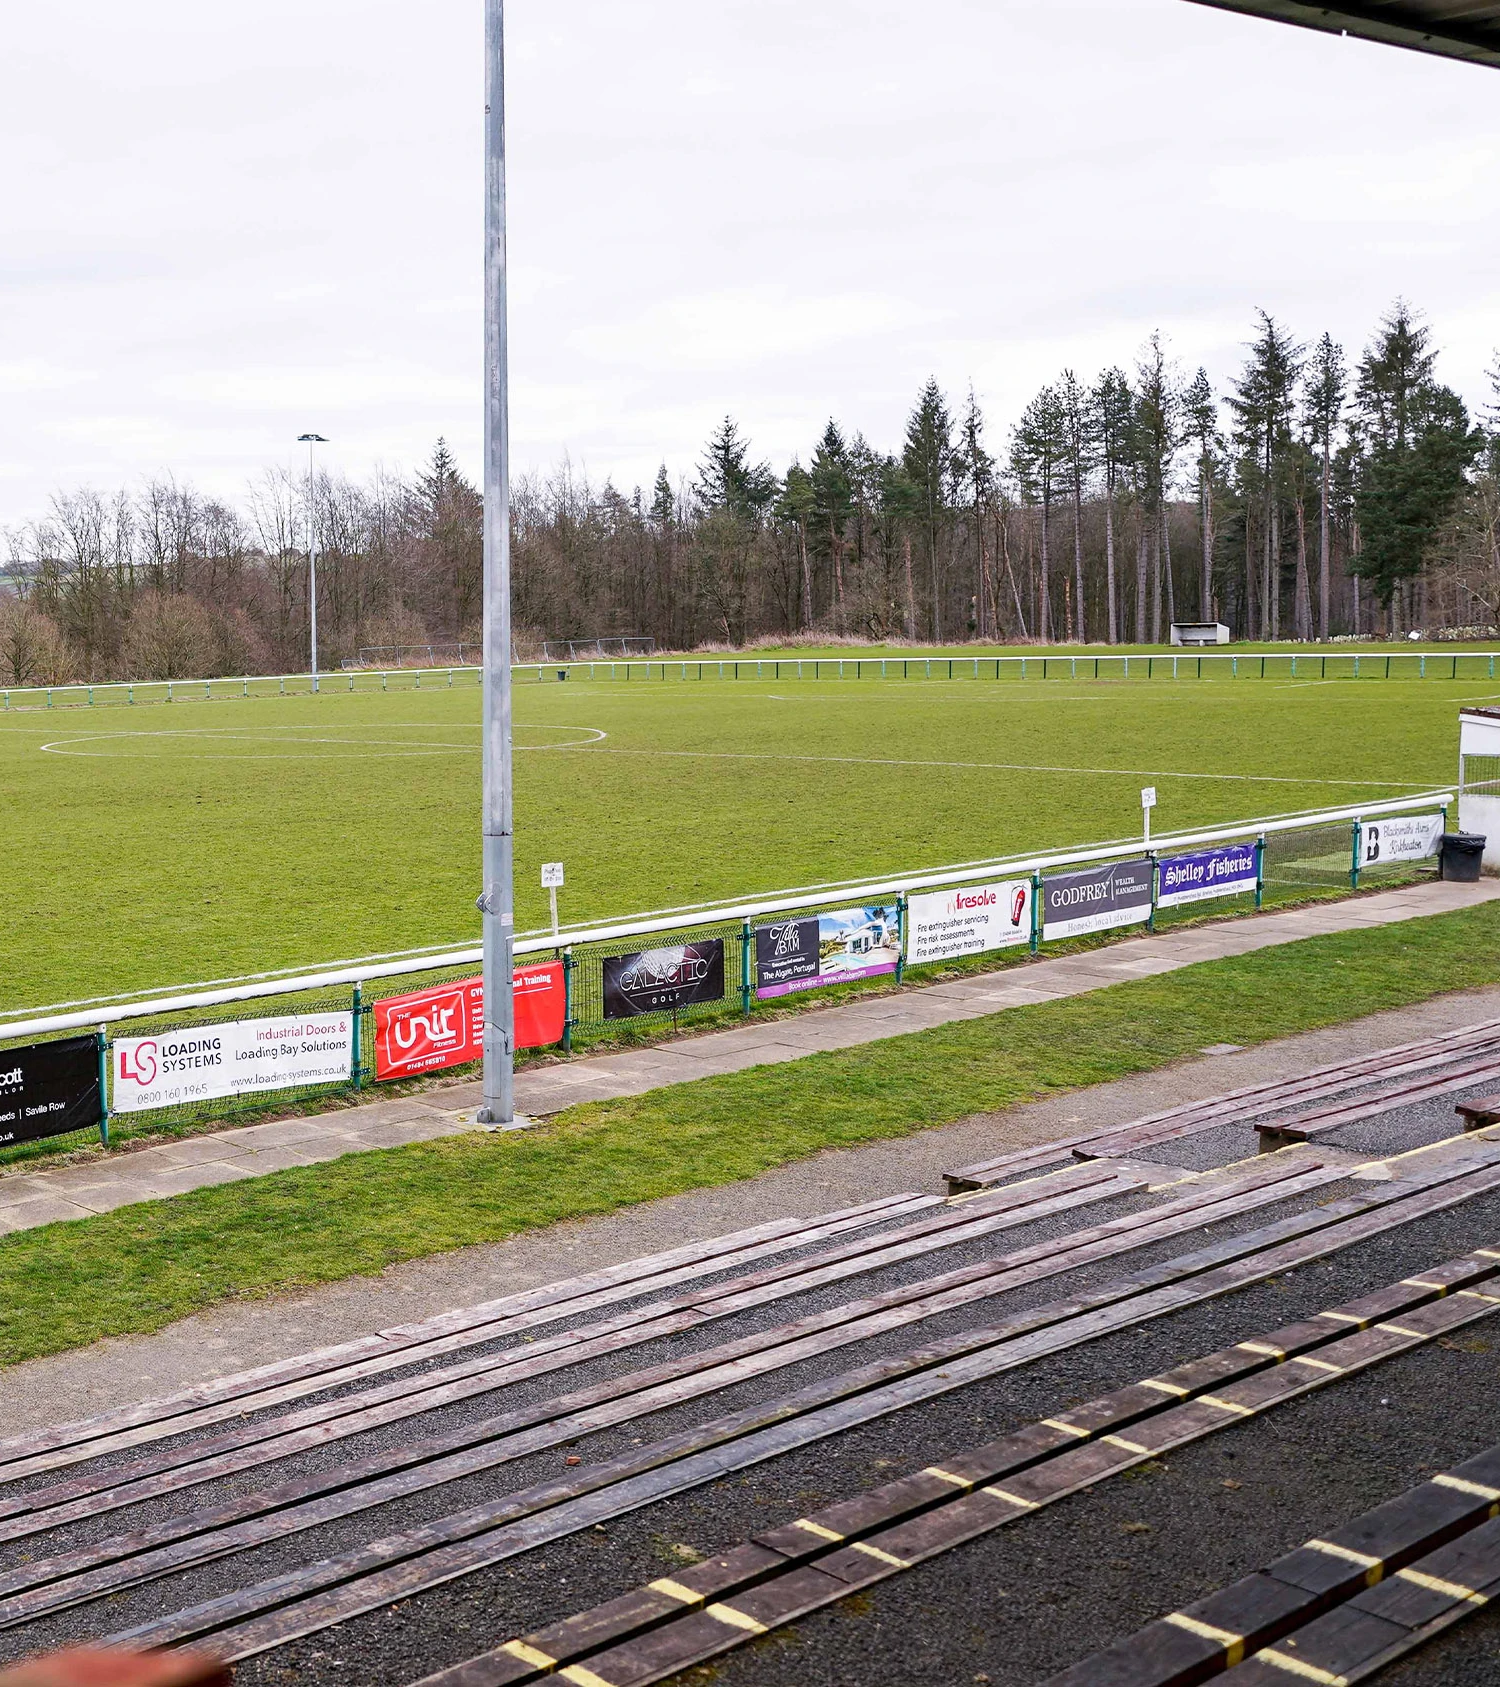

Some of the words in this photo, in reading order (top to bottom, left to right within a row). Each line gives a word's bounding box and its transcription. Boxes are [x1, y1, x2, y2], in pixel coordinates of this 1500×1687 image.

[1115, 876, 1135, 886] WEALTH
[1165, 862, 1204, 887] Shelley
[1051, 881, 1110, 908] GODFREY
[1115, 883, 1148, 896] MANAGEMENT
[917, 924, 927, 933] Fire
[928, 918, 964, 931] extinguisher
[964, 914, 989, 926] servicing
[917, 936, 927, 945] Fire
[928, 933, 939, 943] risk
[940, 928, 975, 941] assessments
[916, 948, 927, 958] Fire
[928, 944, 964, 956] extinguisher
[964, 938, 985, 950] training
[524, 973, 552, 986] Training
[619, 958, 709, 992] GALACTIC
[763, 971, 775, 981] The
[793, 961, 816, 974] Portugal
[788, 980, 802, 991] Book
[651, 993, 681, 1005] GOLF
[397, 1011, 412, 1021] THE
[256, 1025, 304, 1041] Industrial
[306, 1022, 336, 1036] Doors
[339, 1020, 347, 1033] &
[162, 1037, 222, 1058] LOADING
[235, 1047, 278, 1062] Loading
[280, 1044, 298, 1059] Bay
[301, 1040, 347, 1054] Solutions
[162, 1053, 222, 1073] SYSTEMS
[137, 1089, 161, 1104] 0800
[164, 1087, 181, 1099] 160
[184, 1083, 208, 1096] 1965
[25, 1104, 47, 1117] Savile
[49, 1100, 66, 1112] Row
